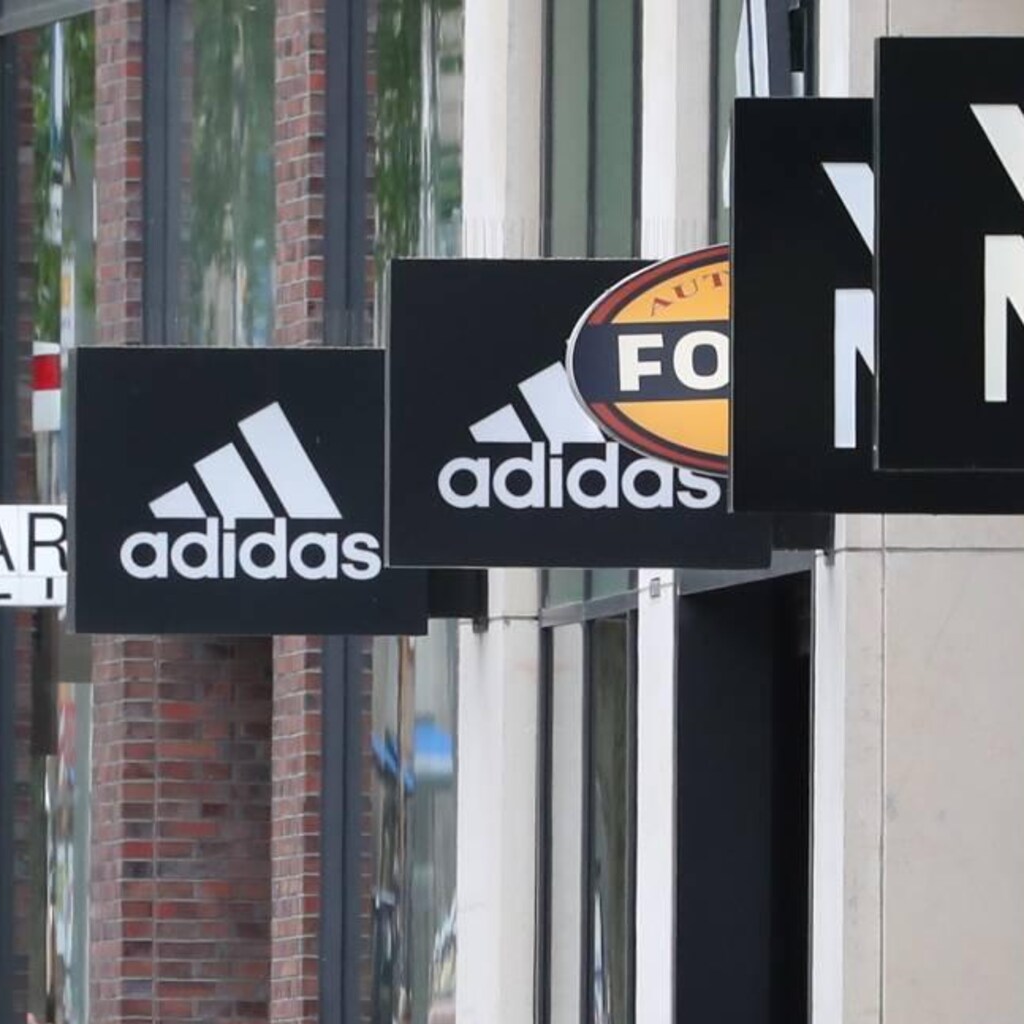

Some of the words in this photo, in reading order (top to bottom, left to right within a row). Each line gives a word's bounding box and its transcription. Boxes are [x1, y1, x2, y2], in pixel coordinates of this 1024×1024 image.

[618, 330, 730, 391] FO
[437, 441, 721, 509] adidas
[120, 518, 382, 580] adidas
